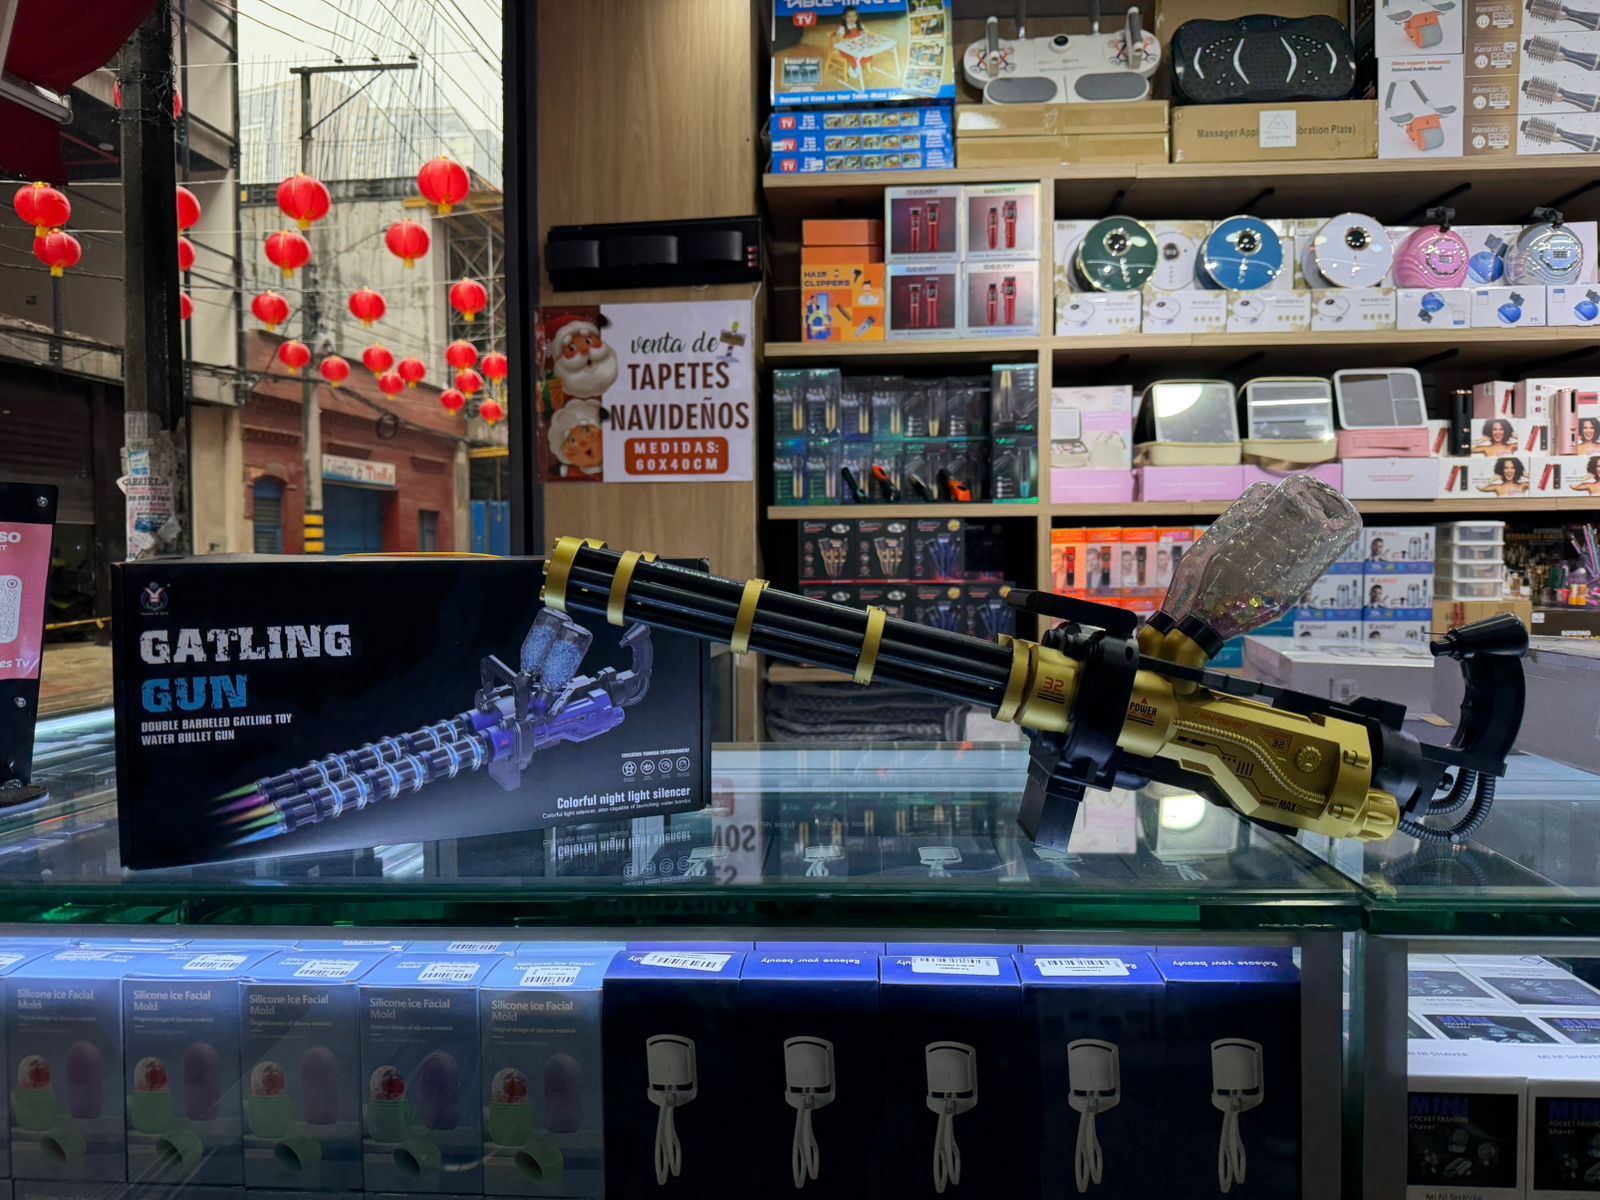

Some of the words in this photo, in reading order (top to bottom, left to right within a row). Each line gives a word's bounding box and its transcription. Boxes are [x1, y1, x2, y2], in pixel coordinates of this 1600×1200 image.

[796, 15, 812, 25] TV
[781, 117, 793, 129] TV
[1197, 128, 1238, 140] Massager
[1330, 123, 1356, 135] Plate)
[782, 160, 795, 171] TV
[804, 271, 827, 279] HAIR
[804, 279, 851, 287] CLIPPERS
[631, 332, 686, 354] venta
[692, 331, 719, 352] de
[627, 362, 730, 390] TAPETES
[610, 396, 750, 431] NAVIDEÑOS
[634, 441, 719, 454] MEDIDAS:
[636, 458, 718, 470] 60X40CM
[139, 624, 351, 664] GATLING
[15, 658, 29, 668] Tv
[1044, 676, 1064, 692] 32
[141, 674, 248, 712] GUN
[1129, 702, 1157, 716] POWER
[141, 720, 180, 733] DOUBLE
[182, 717, 230, 730] BARRELED
[233, 714, 272, 727] GATLING
[275, 713, 292, 724] TOY
[141, 733, 175, 746] WATER
[178, 731, 212, 744] BULLET
[215, 729, 235, 741] GUN
[1272, 739, 1286, 749] 32
[557, 795, 597, 809] Colorful
[599, 792, 625, 807] night
[628, 790, 650, 803] light
[653, 786, 690, 799] silencer
[1279, 799, 1297, 813] MAX
[542, 811, 563, 819] Colorful
[564, 810, 575, 818] light
[761, 957, 794, 966] beauty
[800, 957, 820, 965] your
[823, 957, 860, 965] Release
[1173, 959, 1209, 968] beauty
[1211, 959, 1234, 967] your
[17, 989, 52, 999] Silicone
[53, 990, 67, 999] ice
[68, 989, 94, 1000] Facial
[133, 990, 169, 1001] Silicone
[170, 990, 183, 1001] ice
[184, 990, 211, 1001] Facial
[249, 994, 286, 1004] Silicone
[287, 995, 300, 1004] ice
[302, 995, 329, 1005] Facial
[18, 999, 42, 1009] Mold
[134, 1001, 158, 1011] Mold
[369, 998, 407, 1009] Silicone
[408, 999, 422, 1009] ice
[423, 998, 451, 1009] Facial
[491, 1000, 529, 1011] Silicone
[530, 1001, 545, 1011] ice
[546, 1001, 573, 1011] Facial
[250, 1005, 276, 1015] Mold
[370, 1009, 396, 1019] Mold
[492, 1011, 518, 1021] Mold
[1409, 1096, 1469, 1115] MINI
[1549, 1120, 1576, 1128] POCKET
